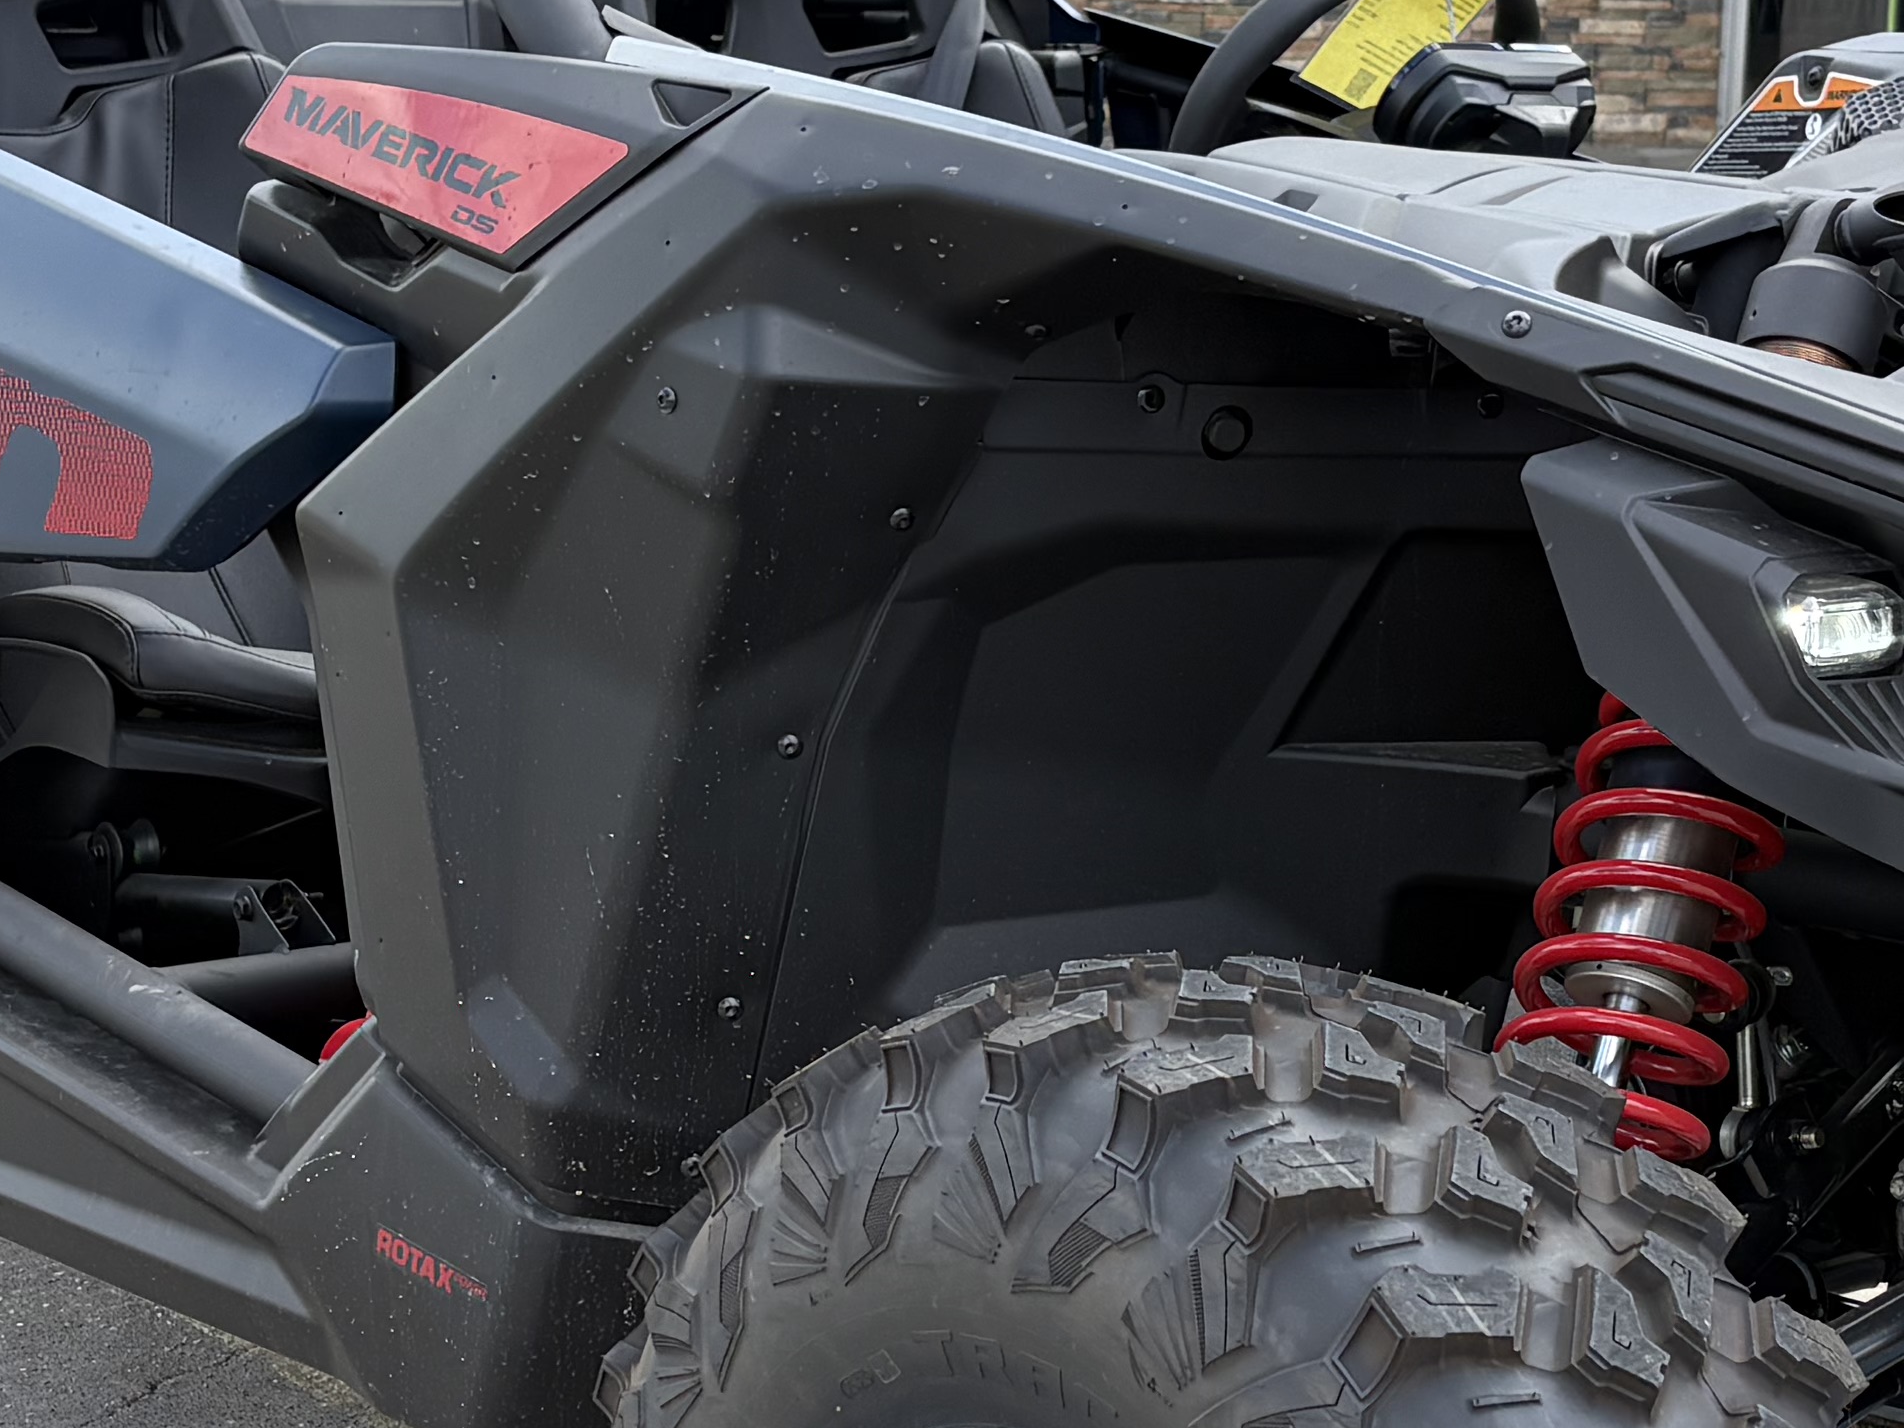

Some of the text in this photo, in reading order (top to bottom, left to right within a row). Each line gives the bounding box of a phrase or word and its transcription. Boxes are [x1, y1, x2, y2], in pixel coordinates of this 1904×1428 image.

[288, 87, 521, 209] MAVERICK
[450, 204, 500, 236] DS
[375, 1227, 455, 1296] ROTAX
